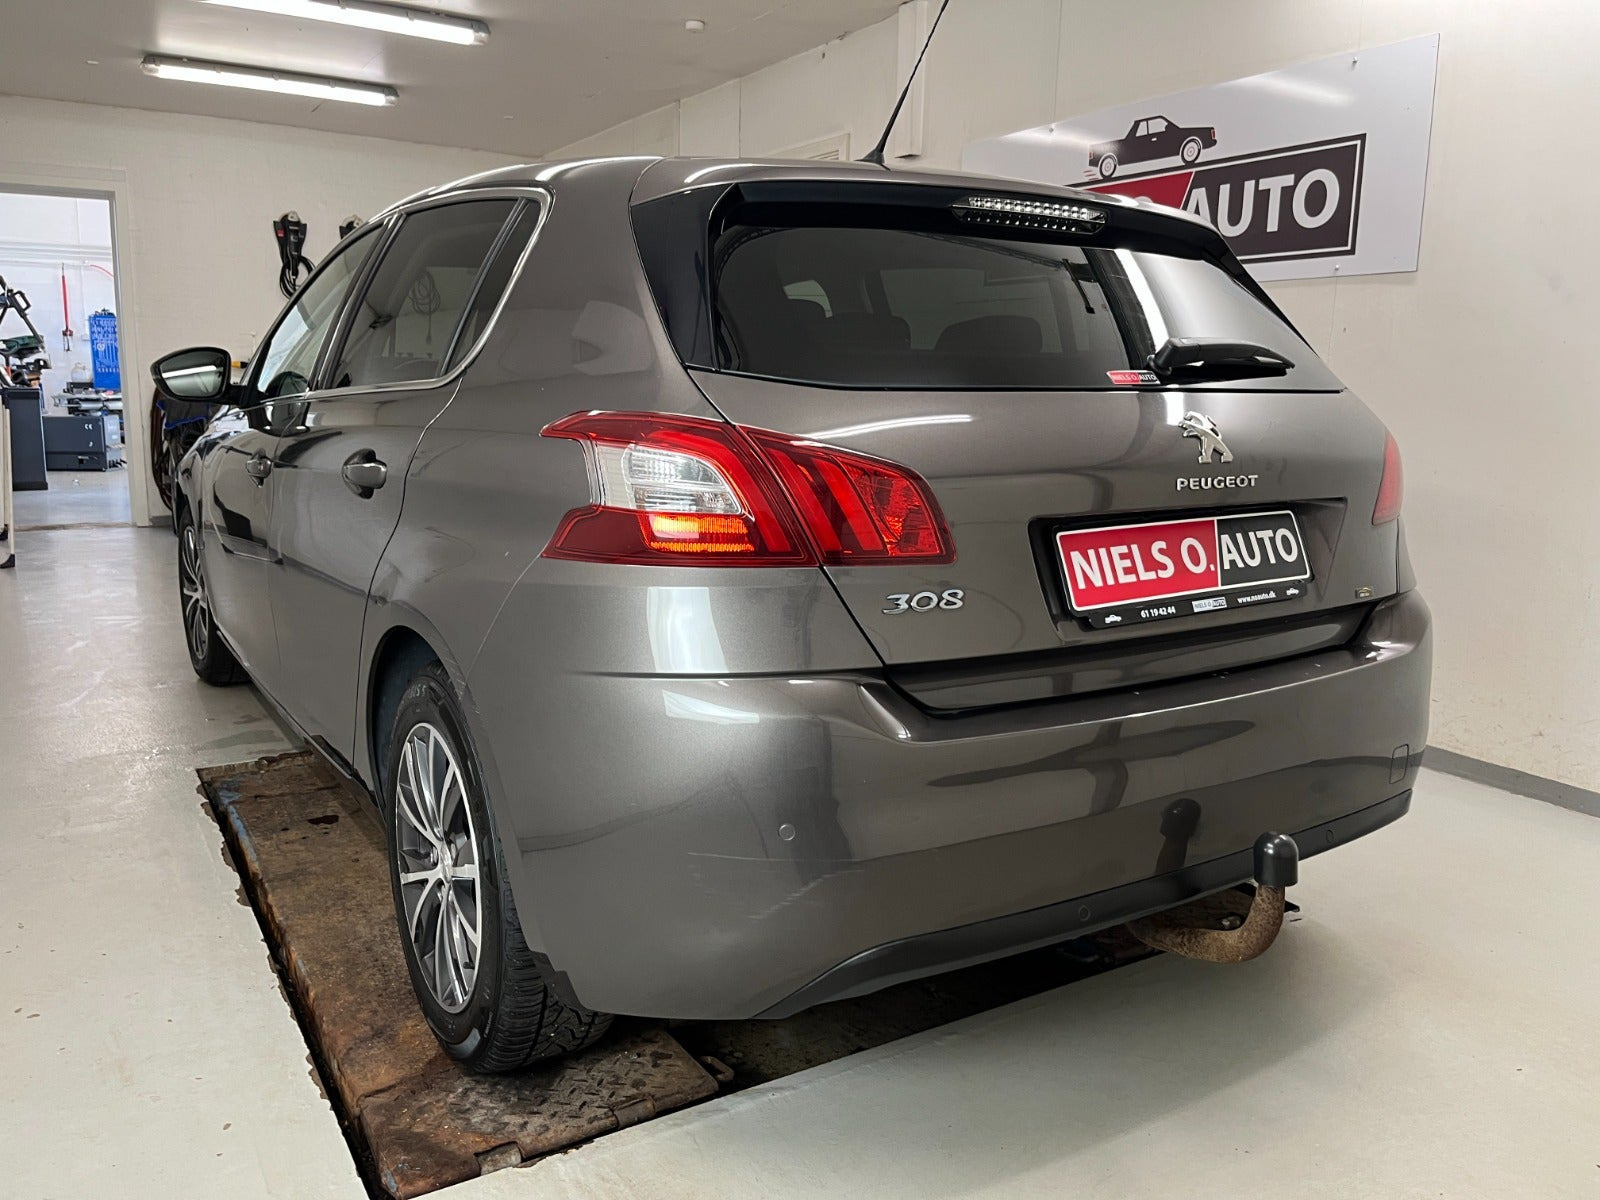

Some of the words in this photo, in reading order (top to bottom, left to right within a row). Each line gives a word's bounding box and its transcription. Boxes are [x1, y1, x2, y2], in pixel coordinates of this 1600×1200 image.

[1176, 475, 1258, 491] PEUGEOT
[1070, 541, 1175, 590] NIELS
[1180, 537, 1215, 574] O.
[1220, 528, 1298, 570] AUTO
[882, 589, 964, 615] 308
[1141, 609, 1150, 618] 61
[1150, 608, 1159, 617] 19
[1159, 607, 1167, 615] 42
[1167, 605, 1176, 614] 44
